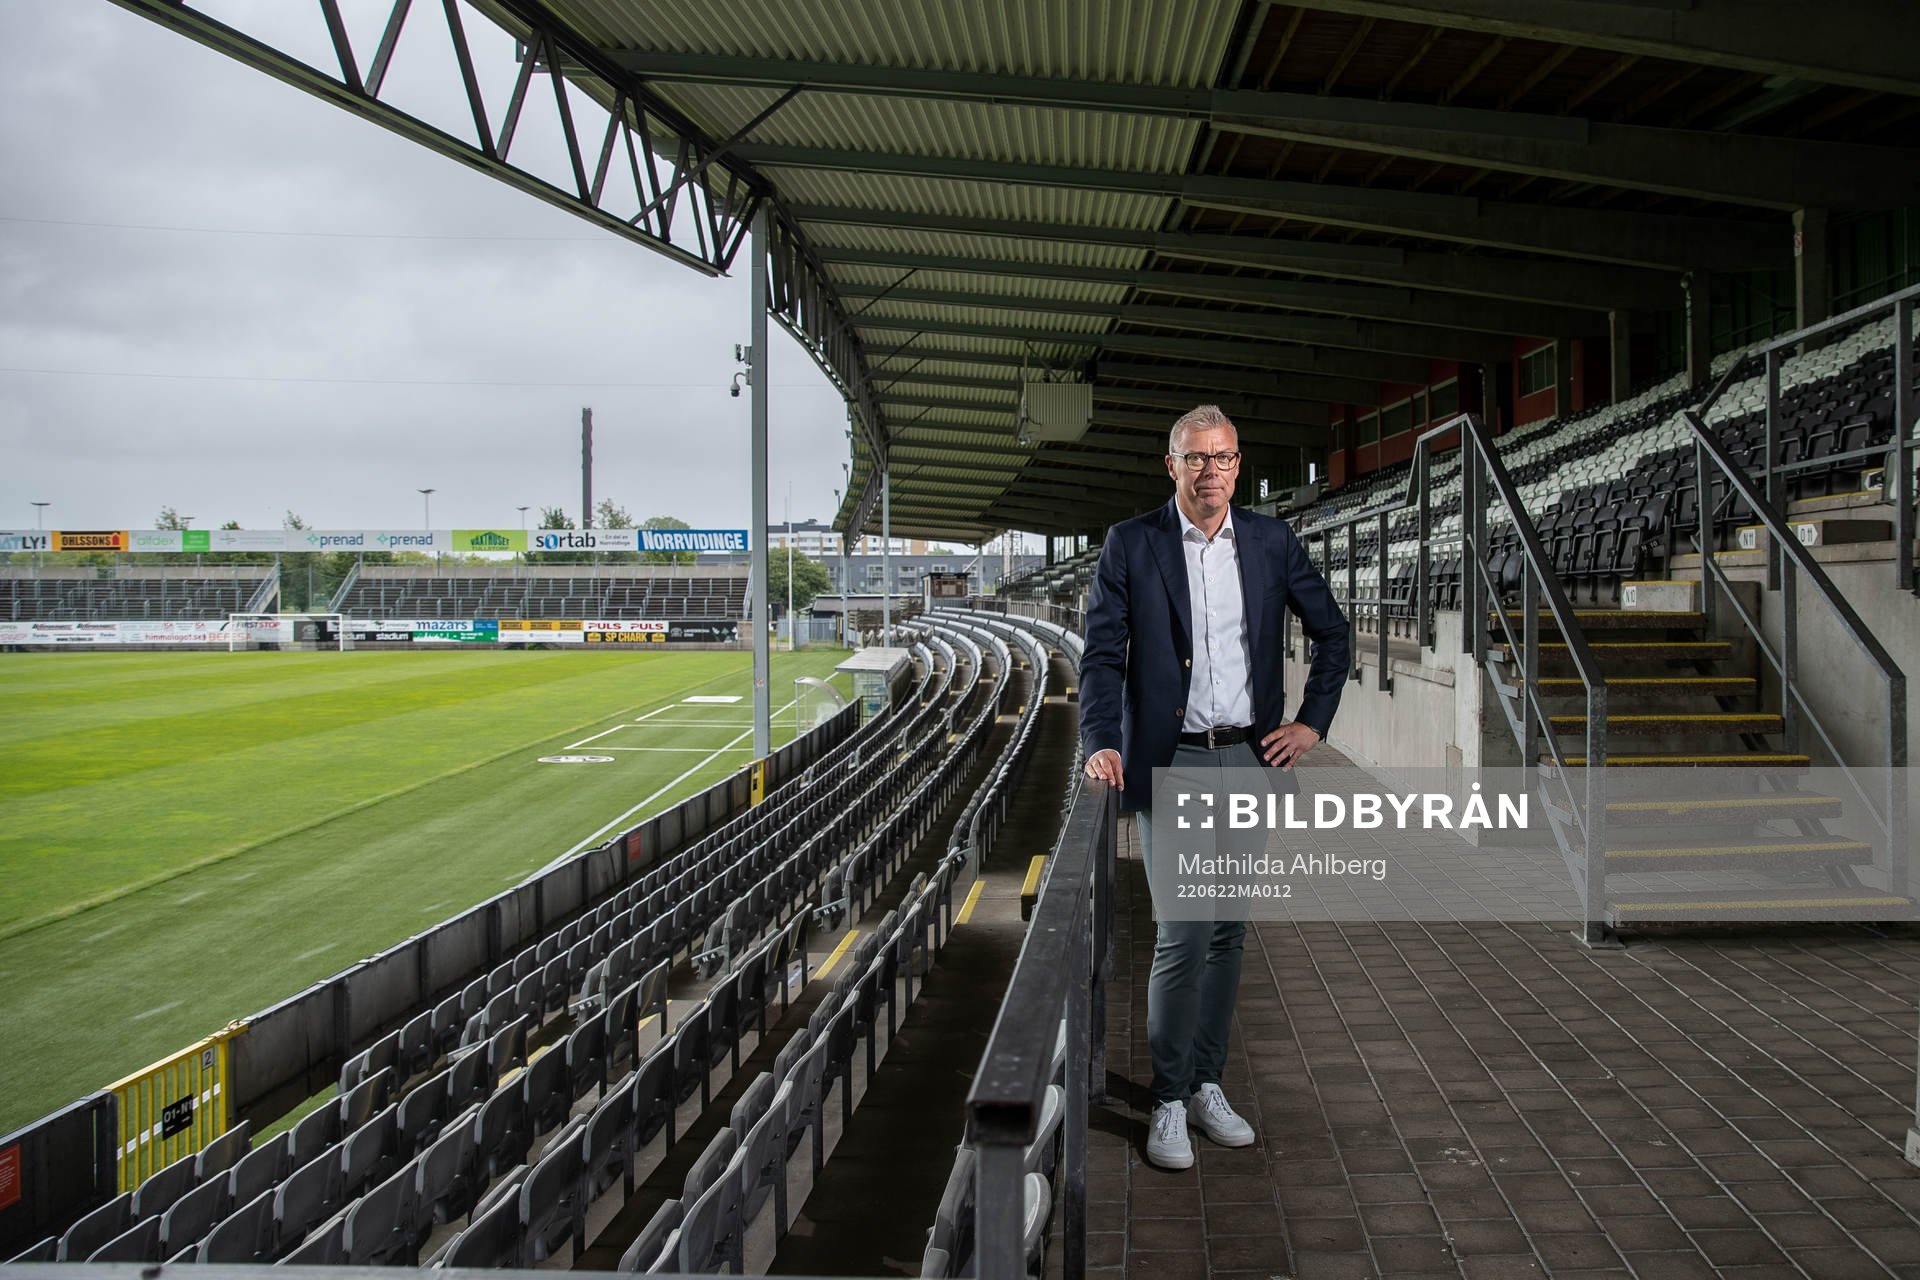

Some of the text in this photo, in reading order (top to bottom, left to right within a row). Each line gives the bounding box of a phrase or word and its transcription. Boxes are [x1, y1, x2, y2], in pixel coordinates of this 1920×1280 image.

[0, 536, 46, 549] ATLY!
[62, 536, 111, 546] OHLSSONS
[320, 533, 364, 548] prenad
[390, 533, 433, 548] prenad
[536, 532, 596, 550] sortab
[642, 531, 745, 550] NORRVIDINGE
[417, 621, 468, 631] mazars
[605, 632, 617, 642] SP
[618, 632, 648, 642] CHARK
[205, 1051, 212, 1065] 2
